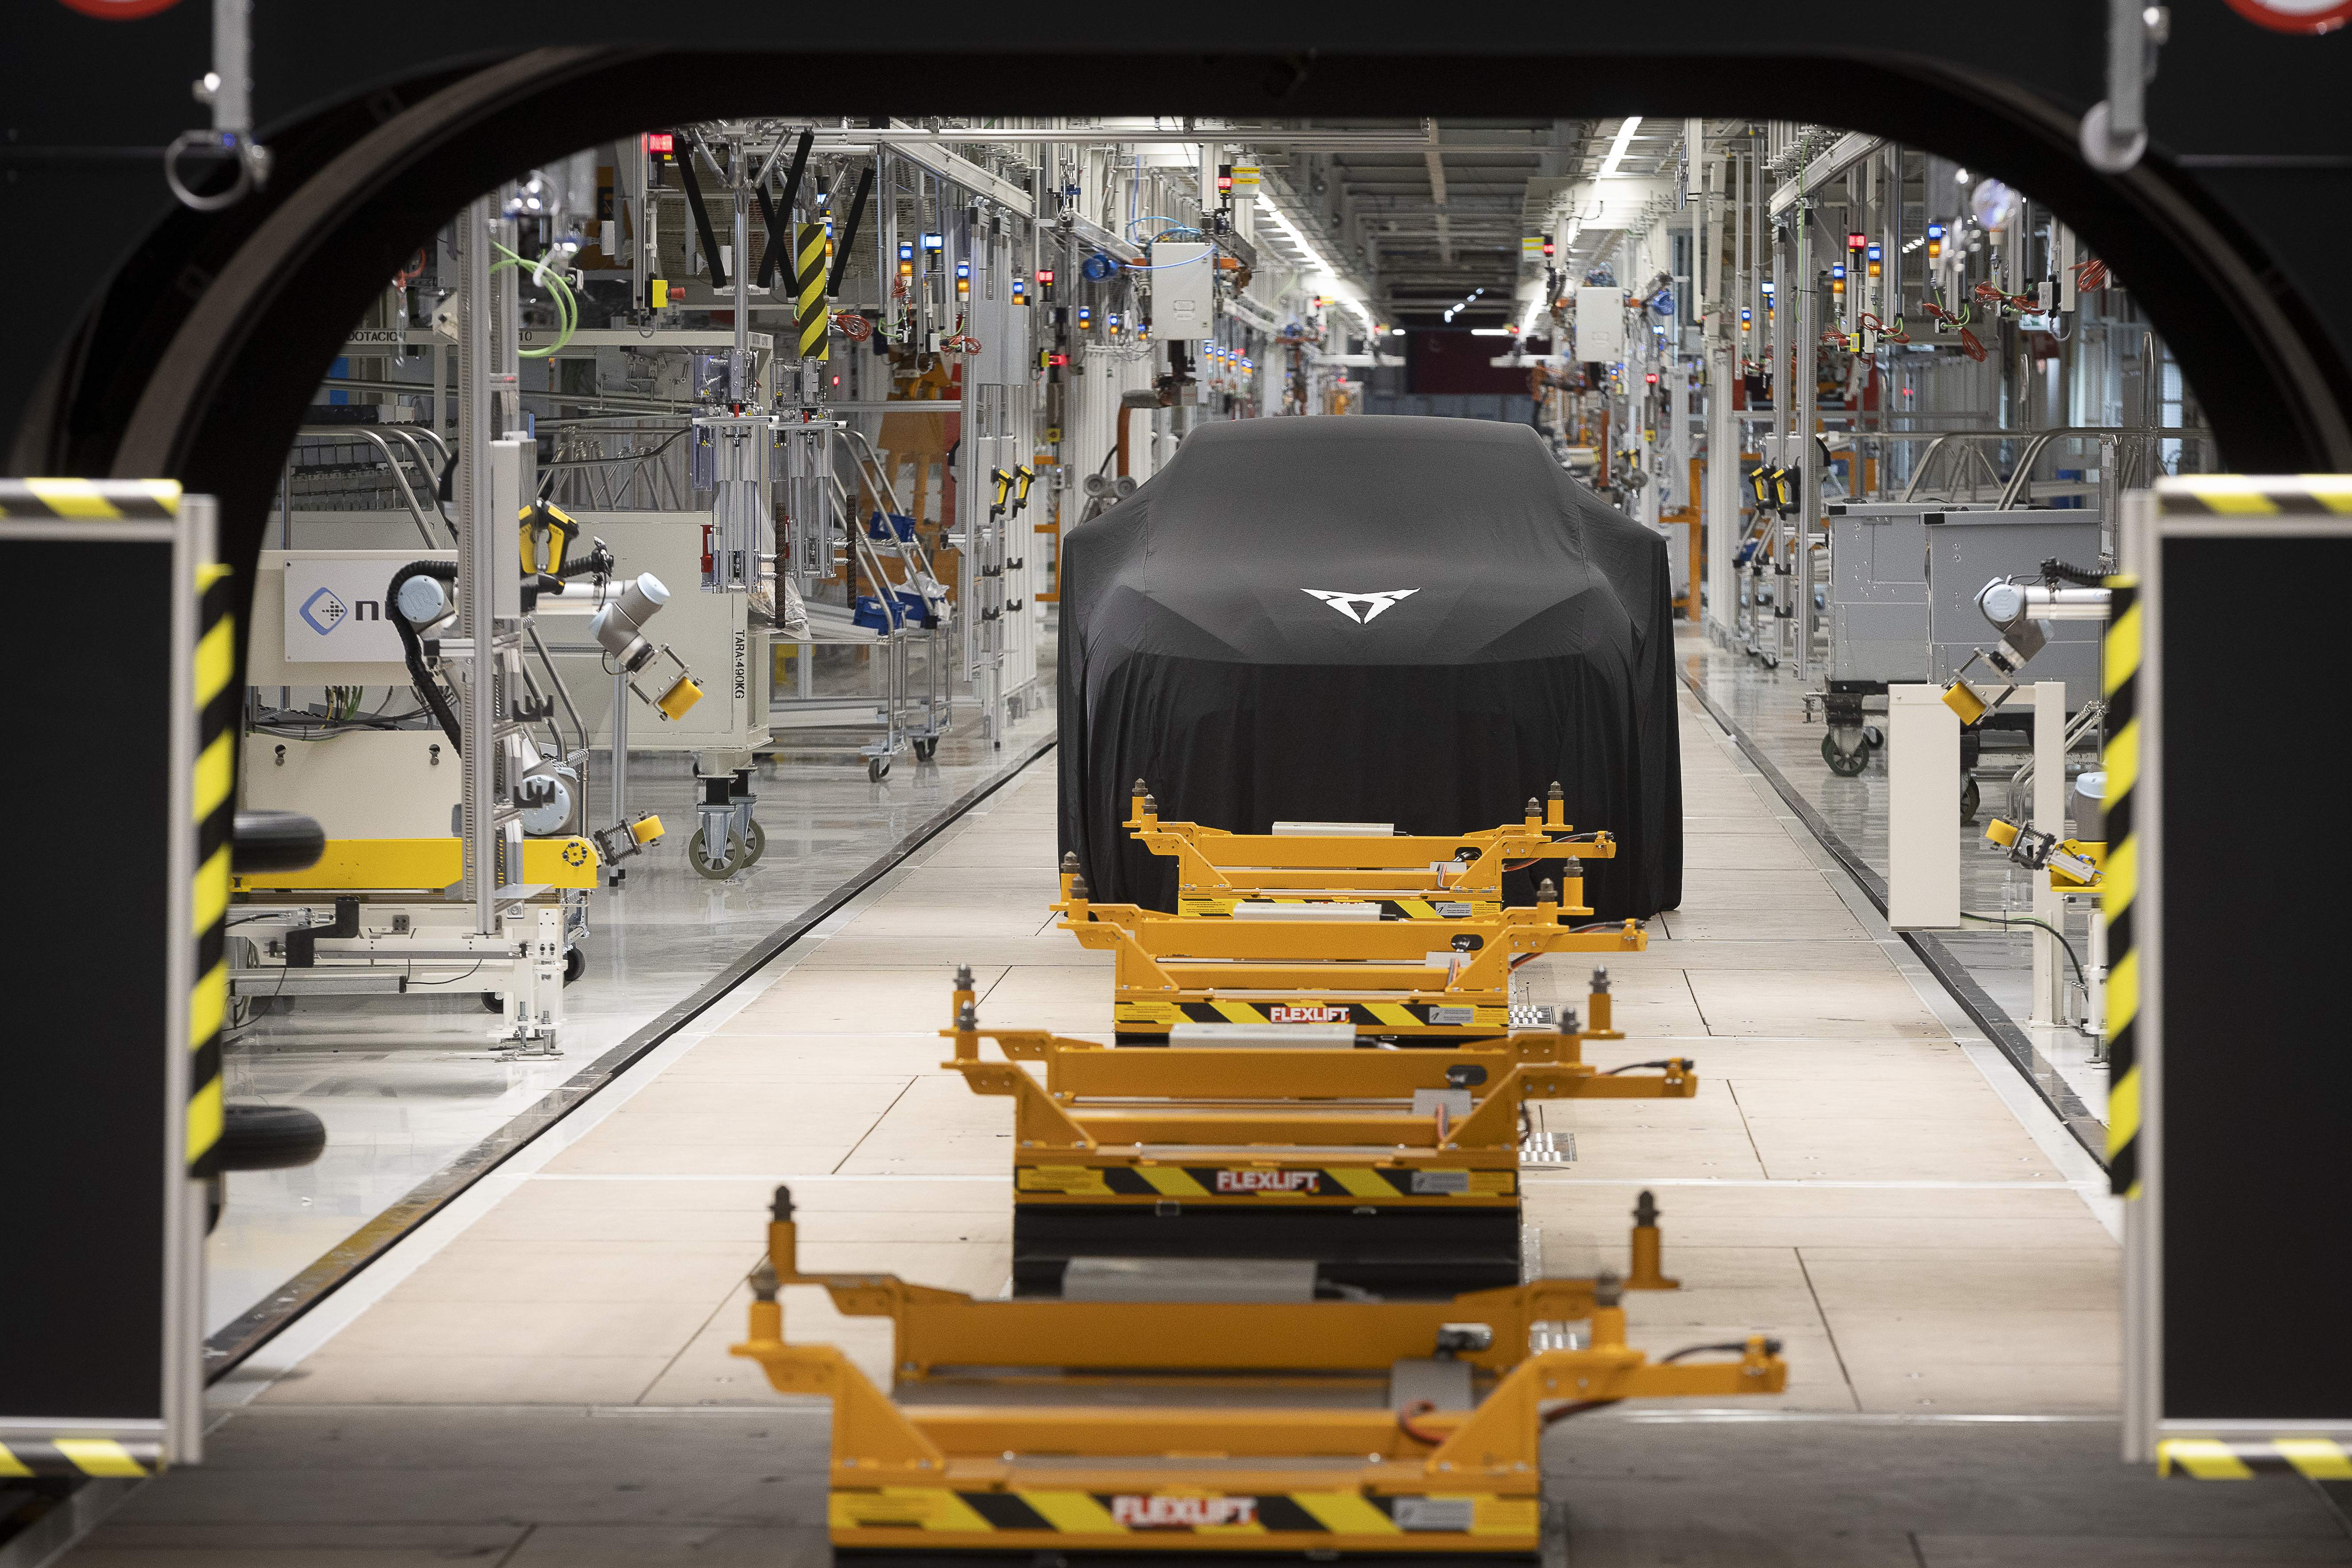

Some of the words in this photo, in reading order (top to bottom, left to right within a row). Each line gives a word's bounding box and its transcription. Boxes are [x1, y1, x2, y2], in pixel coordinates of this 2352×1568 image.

[735, 629, 745, 698] TARA:490KG
[1270, 1007, 1350, 1022] FLEXLIFT
[1217, 1171, 1320, 1190] FLEXLIFT
